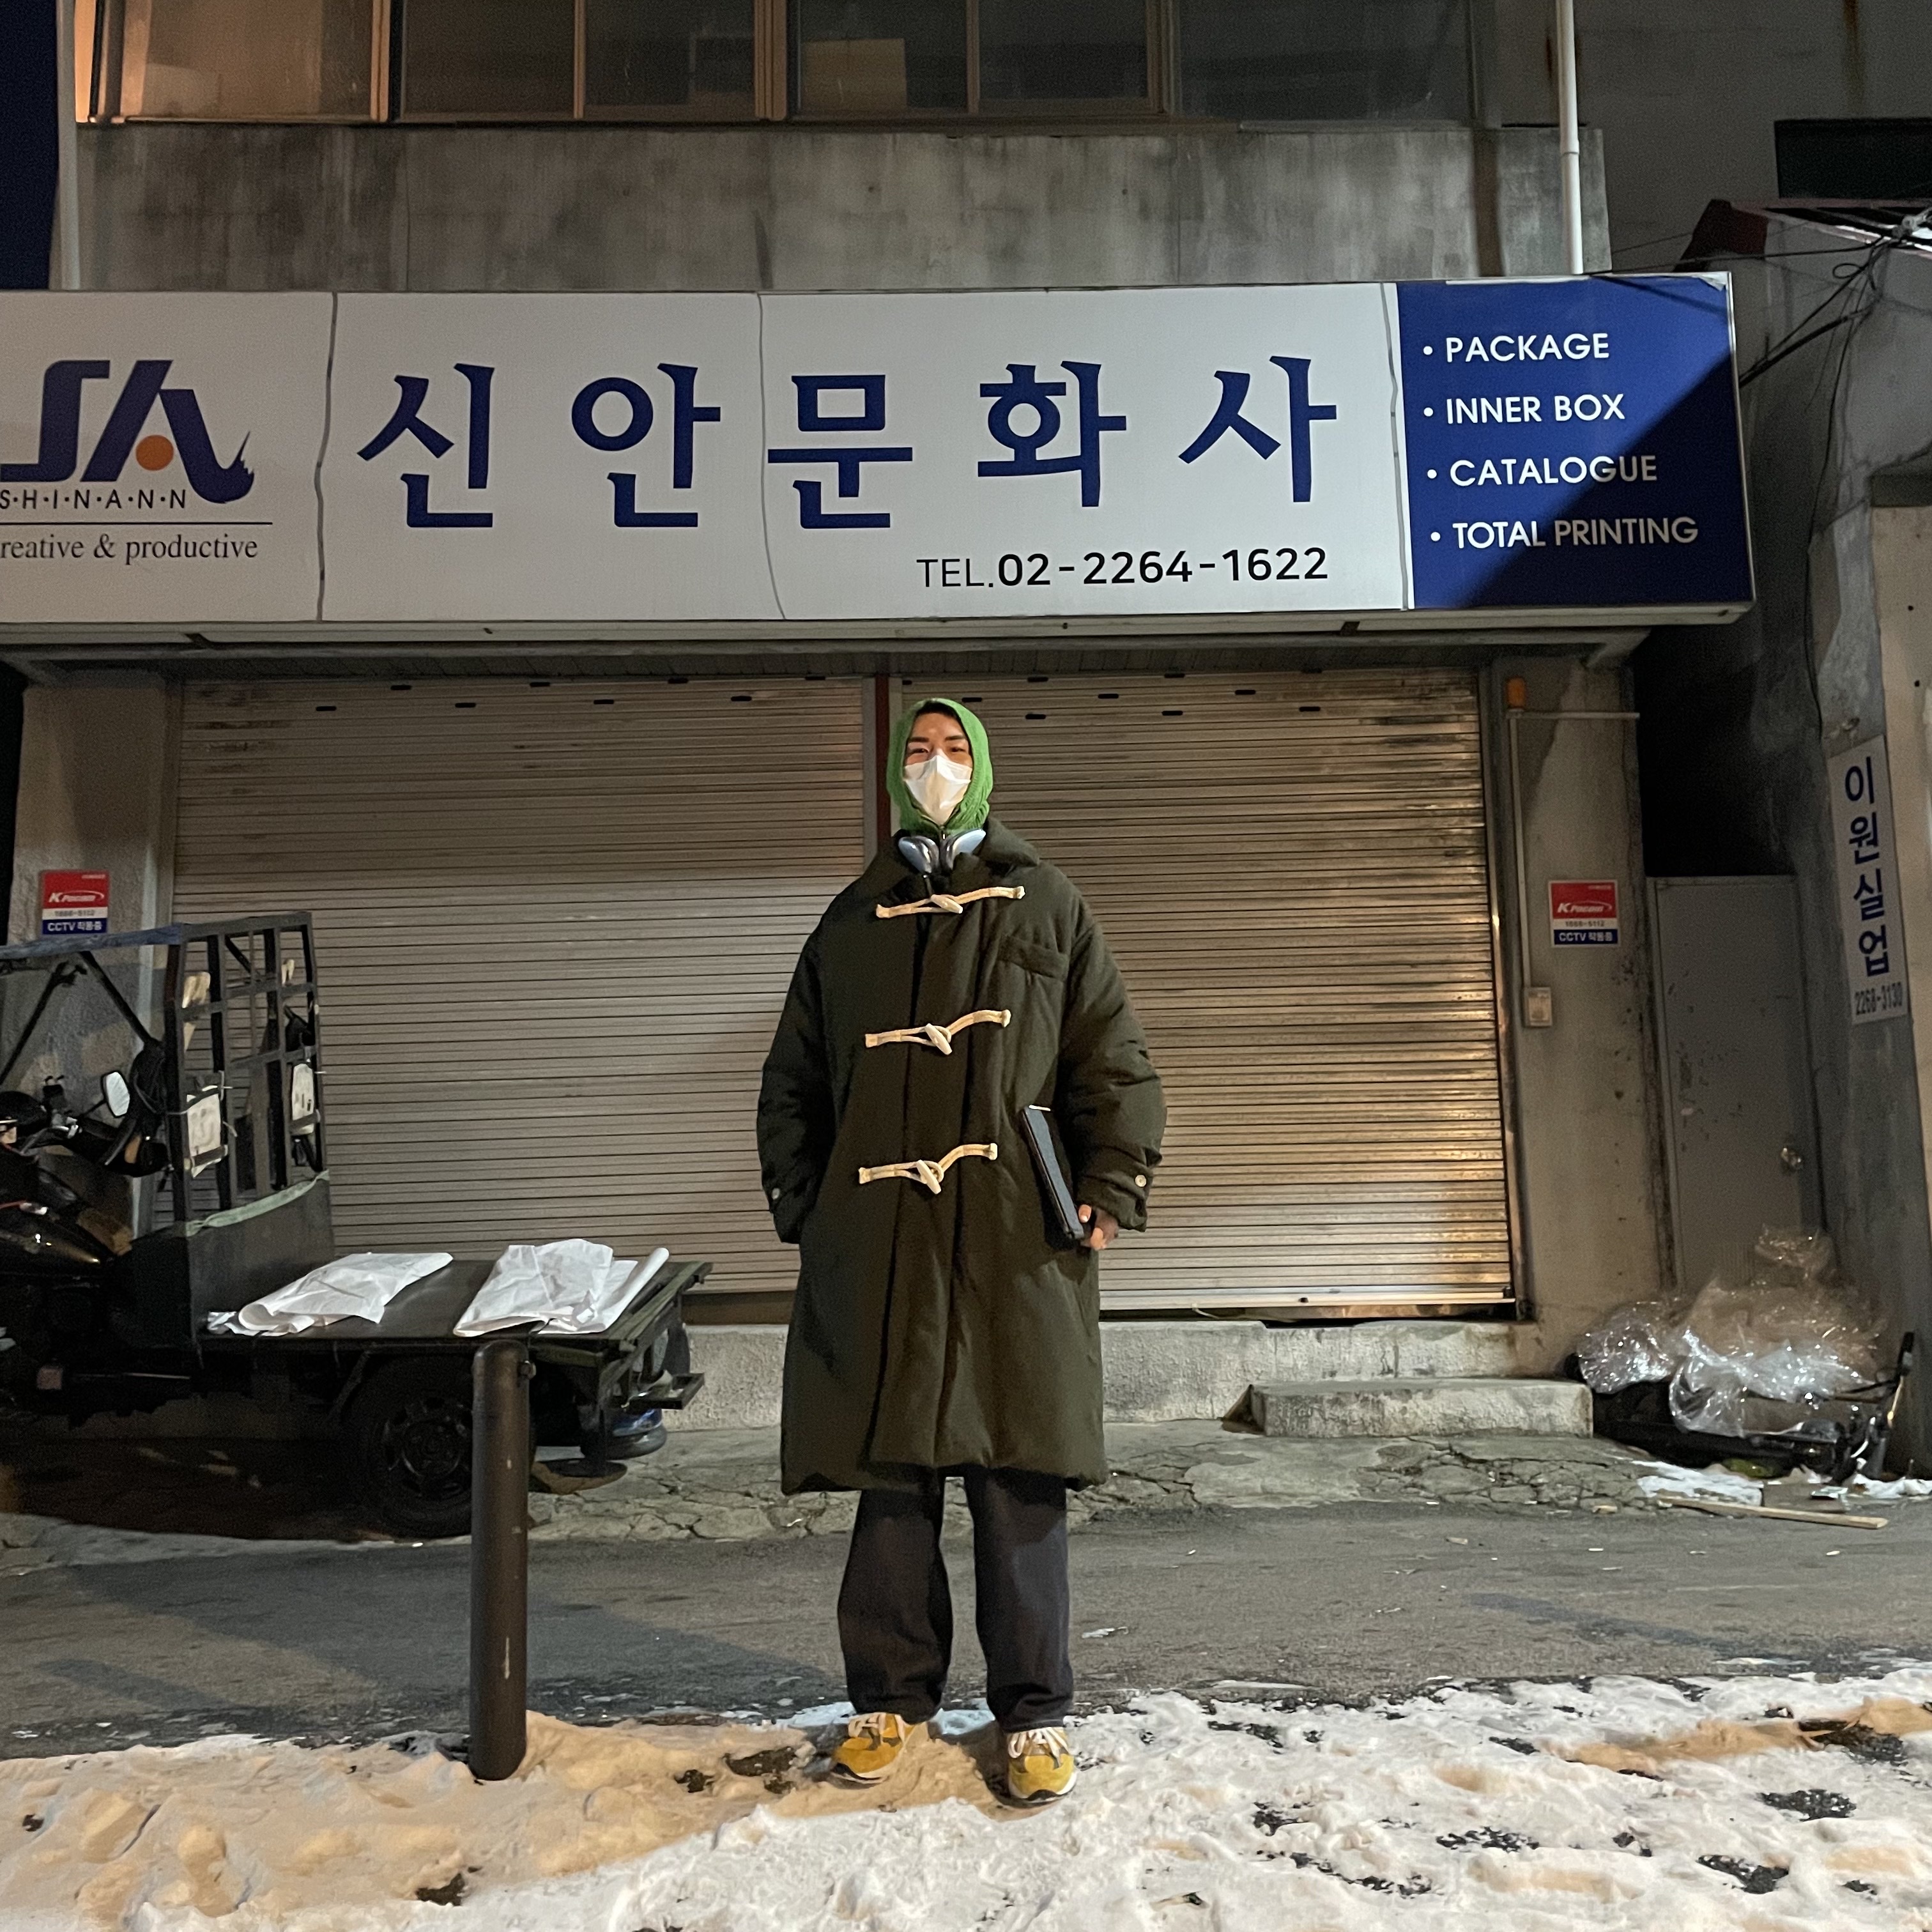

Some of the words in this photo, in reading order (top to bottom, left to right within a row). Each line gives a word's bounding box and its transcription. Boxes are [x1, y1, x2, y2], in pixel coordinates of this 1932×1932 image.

[1445, 333, 1609, 363] PACKAGE
[1446, 396, 1542, 424] INNER
[1554, 394, 1625, 422] BOX
[356, 355, 1337, 530] 신안문화사
[1450, 455, 1657, 487] CATALOGUE
[93, 533, 116, 559] &
[125, 533, 258, 565] productive
[1453, 521, 1545, 549] TOTAL
[1554, 517, 1699, 546] PRINTING
[1844, 756, 1890, 977] 이원실업
[47, 922, 76, 931] CCTV
[1559, 931, 1587, 942] CCTV
